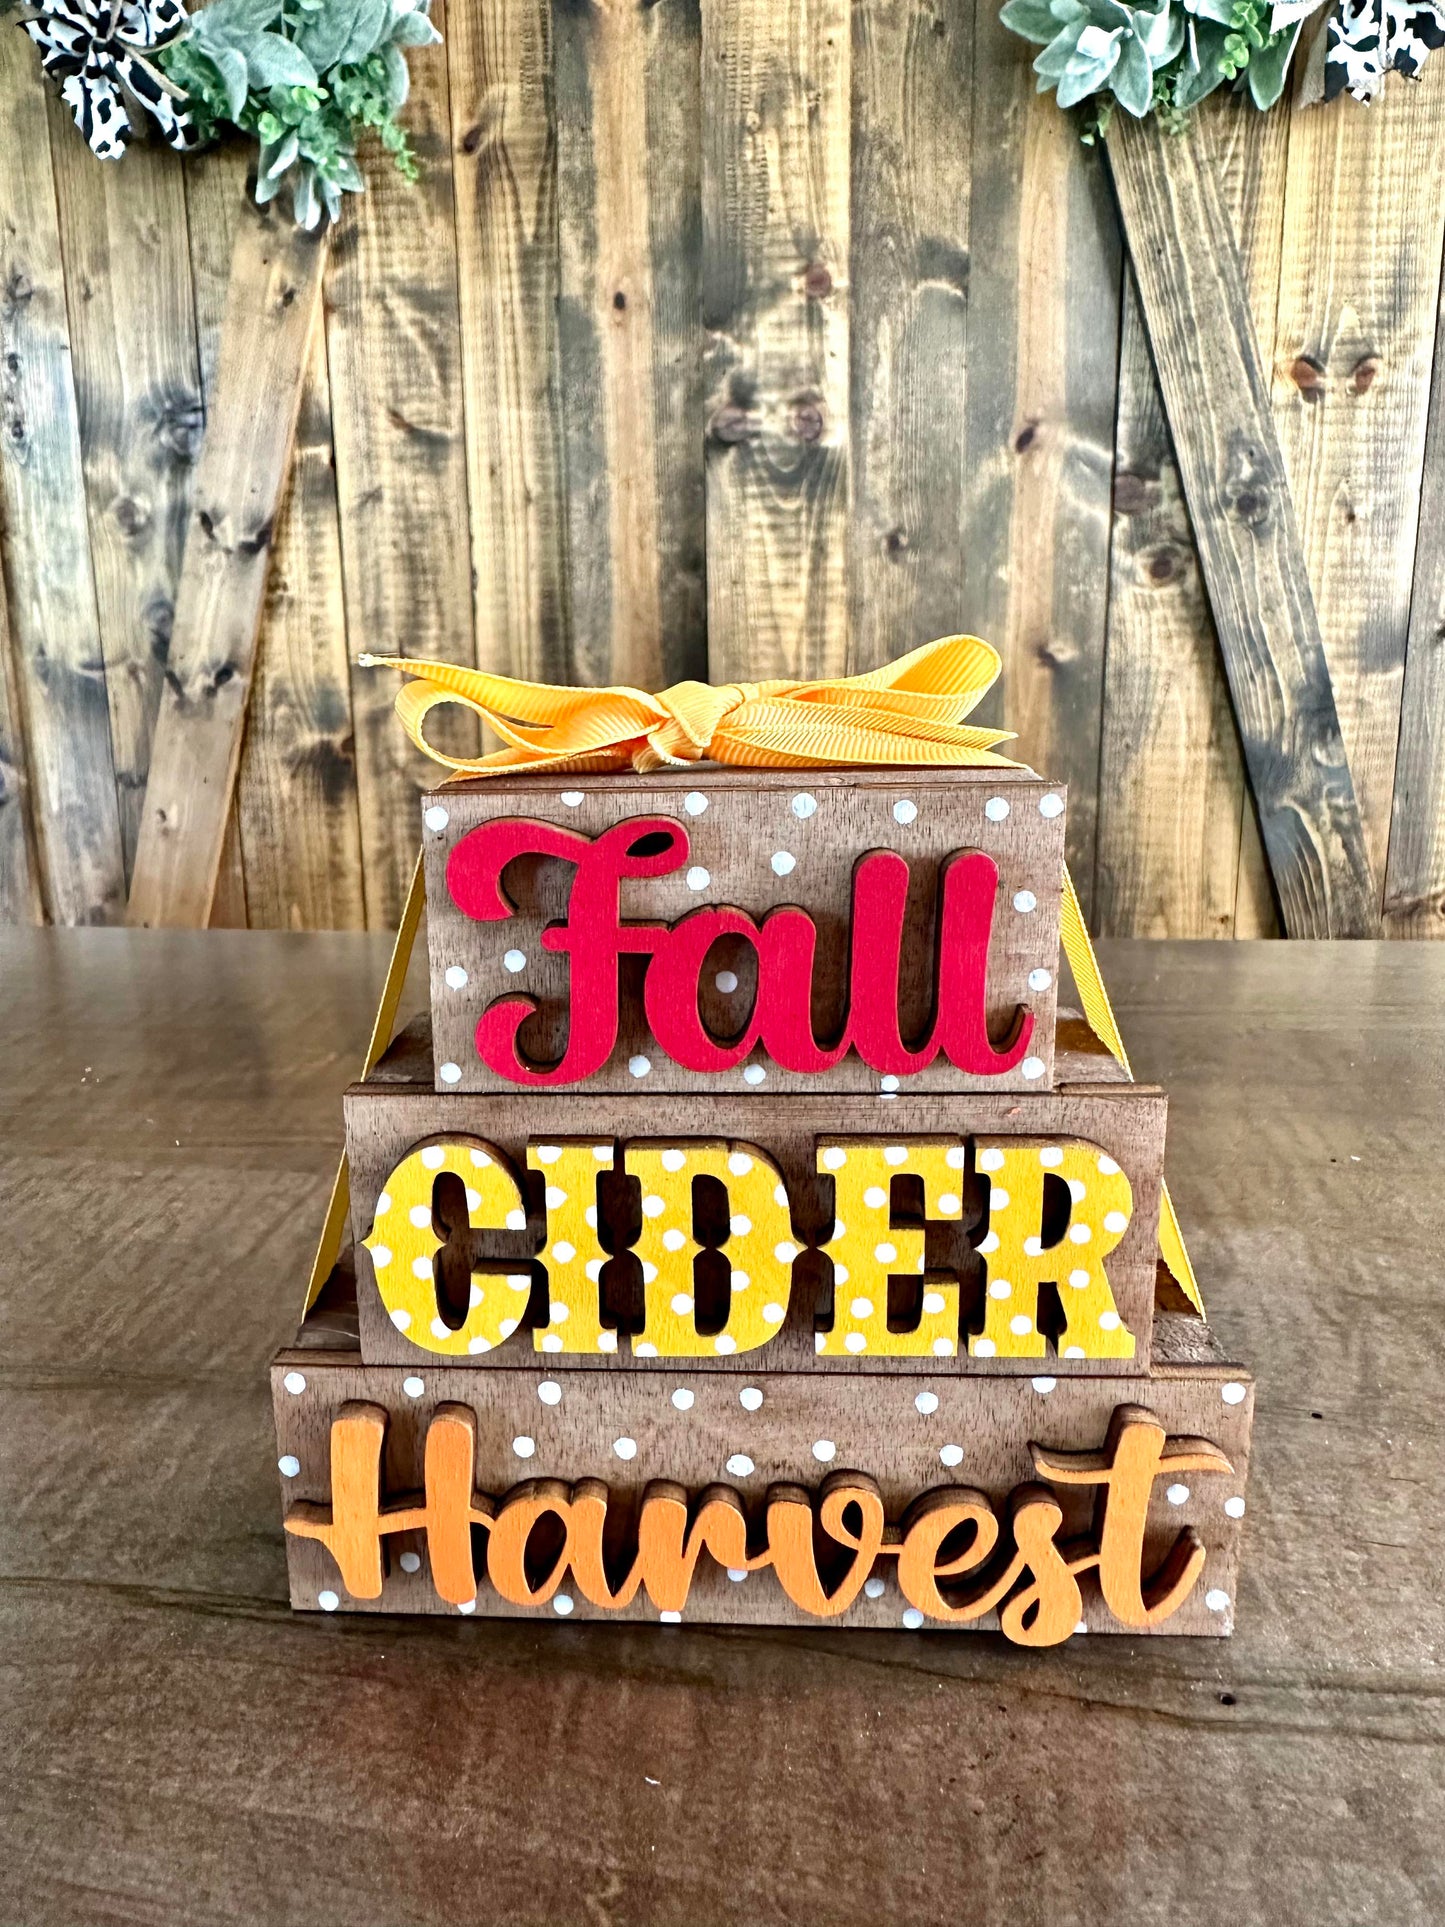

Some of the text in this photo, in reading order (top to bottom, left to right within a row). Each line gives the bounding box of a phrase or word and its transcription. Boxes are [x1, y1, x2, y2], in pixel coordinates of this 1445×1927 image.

[445, 815, 1035, 1088] Fall
[360, 1134, 1137, 1358] CIDER
[283, 1404, 1236, 1648] Harvest
